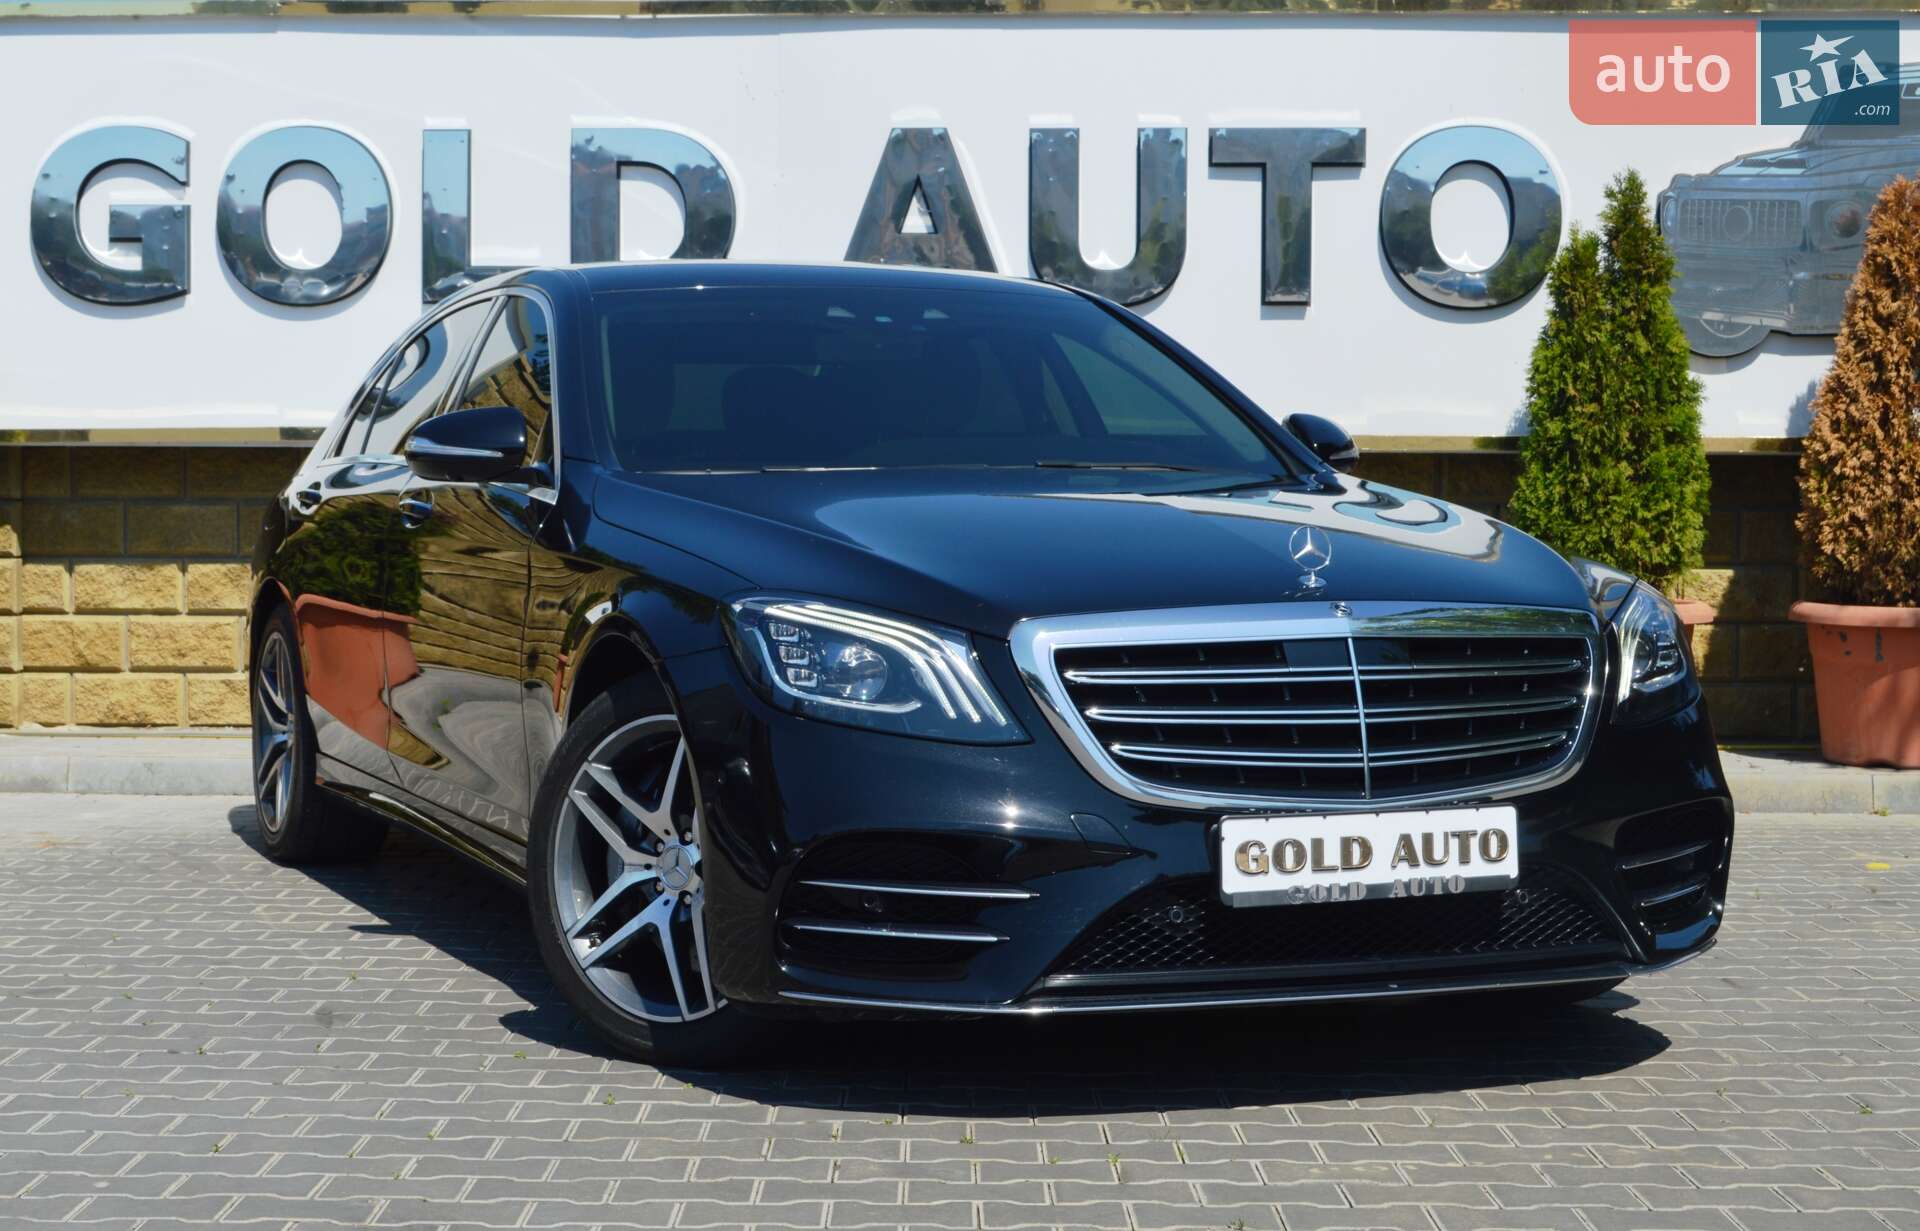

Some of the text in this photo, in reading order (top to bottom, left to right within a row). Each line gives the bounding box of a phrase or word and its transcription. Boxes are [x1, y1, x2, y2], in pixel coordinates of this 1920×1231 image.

[30, 124, 1563, 309] GOLD AUTO
[1234, 828, 1510, 875] GOLD AUTO
[1287, 875, 1466, 905] GOLD AUTO
